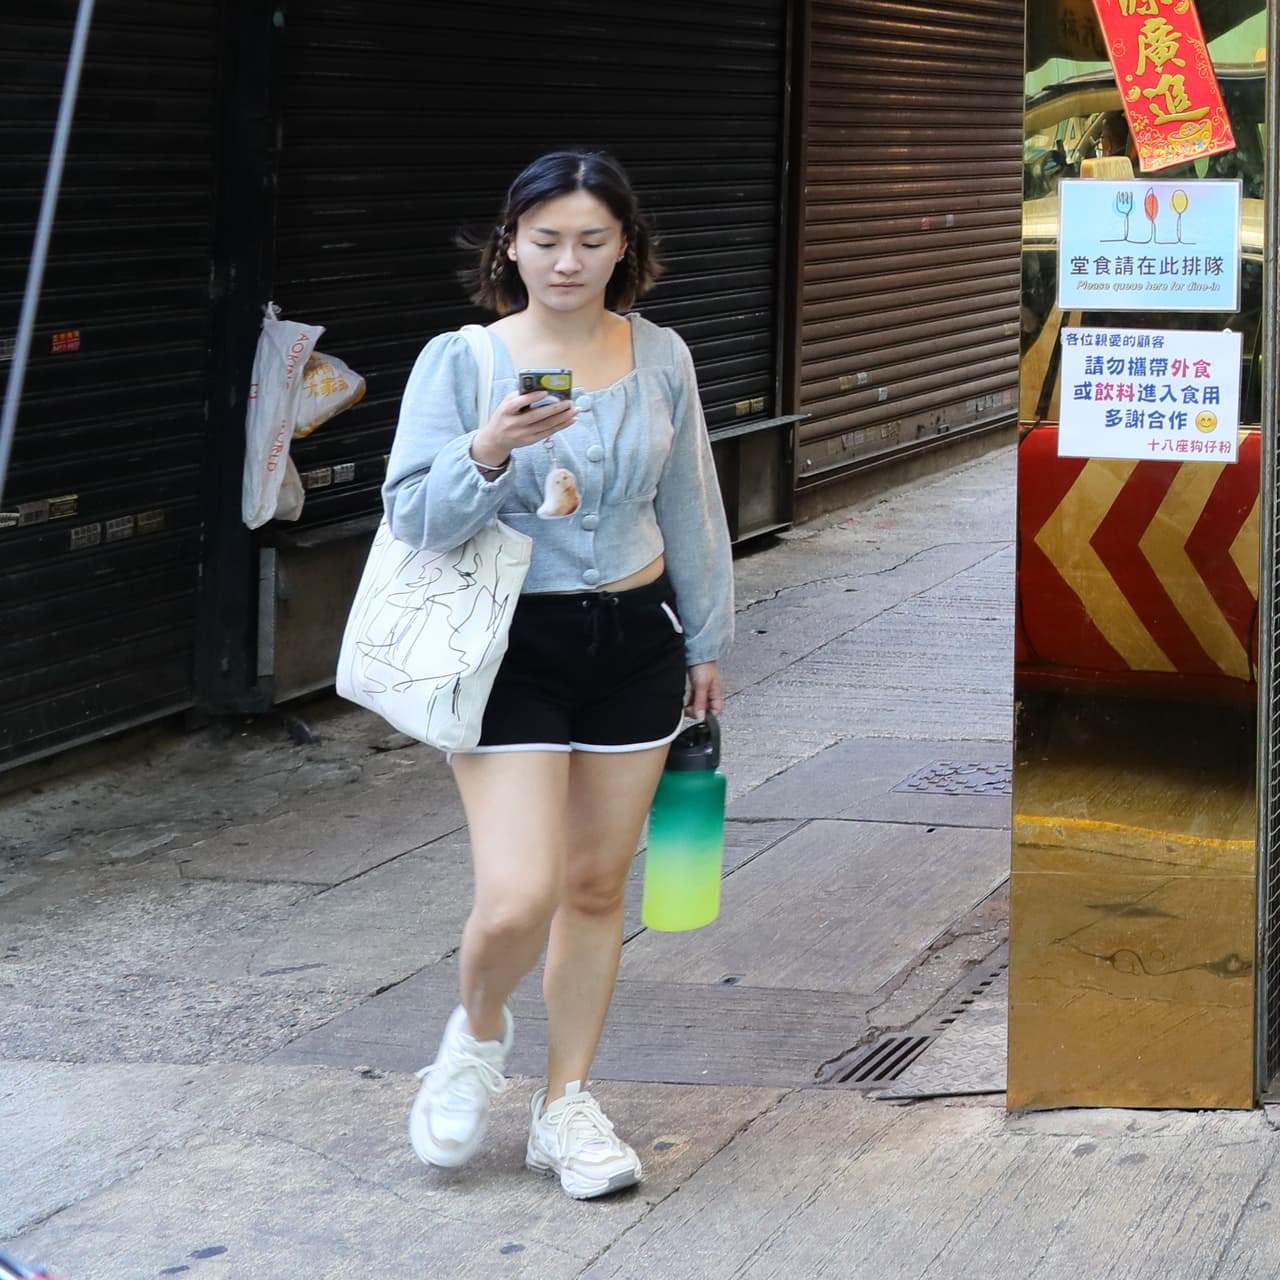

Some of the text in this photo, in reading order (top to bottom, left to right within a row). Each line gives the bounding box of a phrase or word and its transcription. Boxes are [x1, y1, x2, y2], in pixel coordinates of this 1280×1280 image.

[1070, 255, 1225, 276] 堂食請在此排隊
[1065, 332, 1166, 349] 各位親愛的顧客
[1084, 355, 1212, 380] 請勿攜帶外食
[1073, 381, 1221, 405] 或飲料進入食用
[1104, 408, 1188, 430] 多謝合作
[1147, 438, 1232, 454] 十八座狗仔粉
